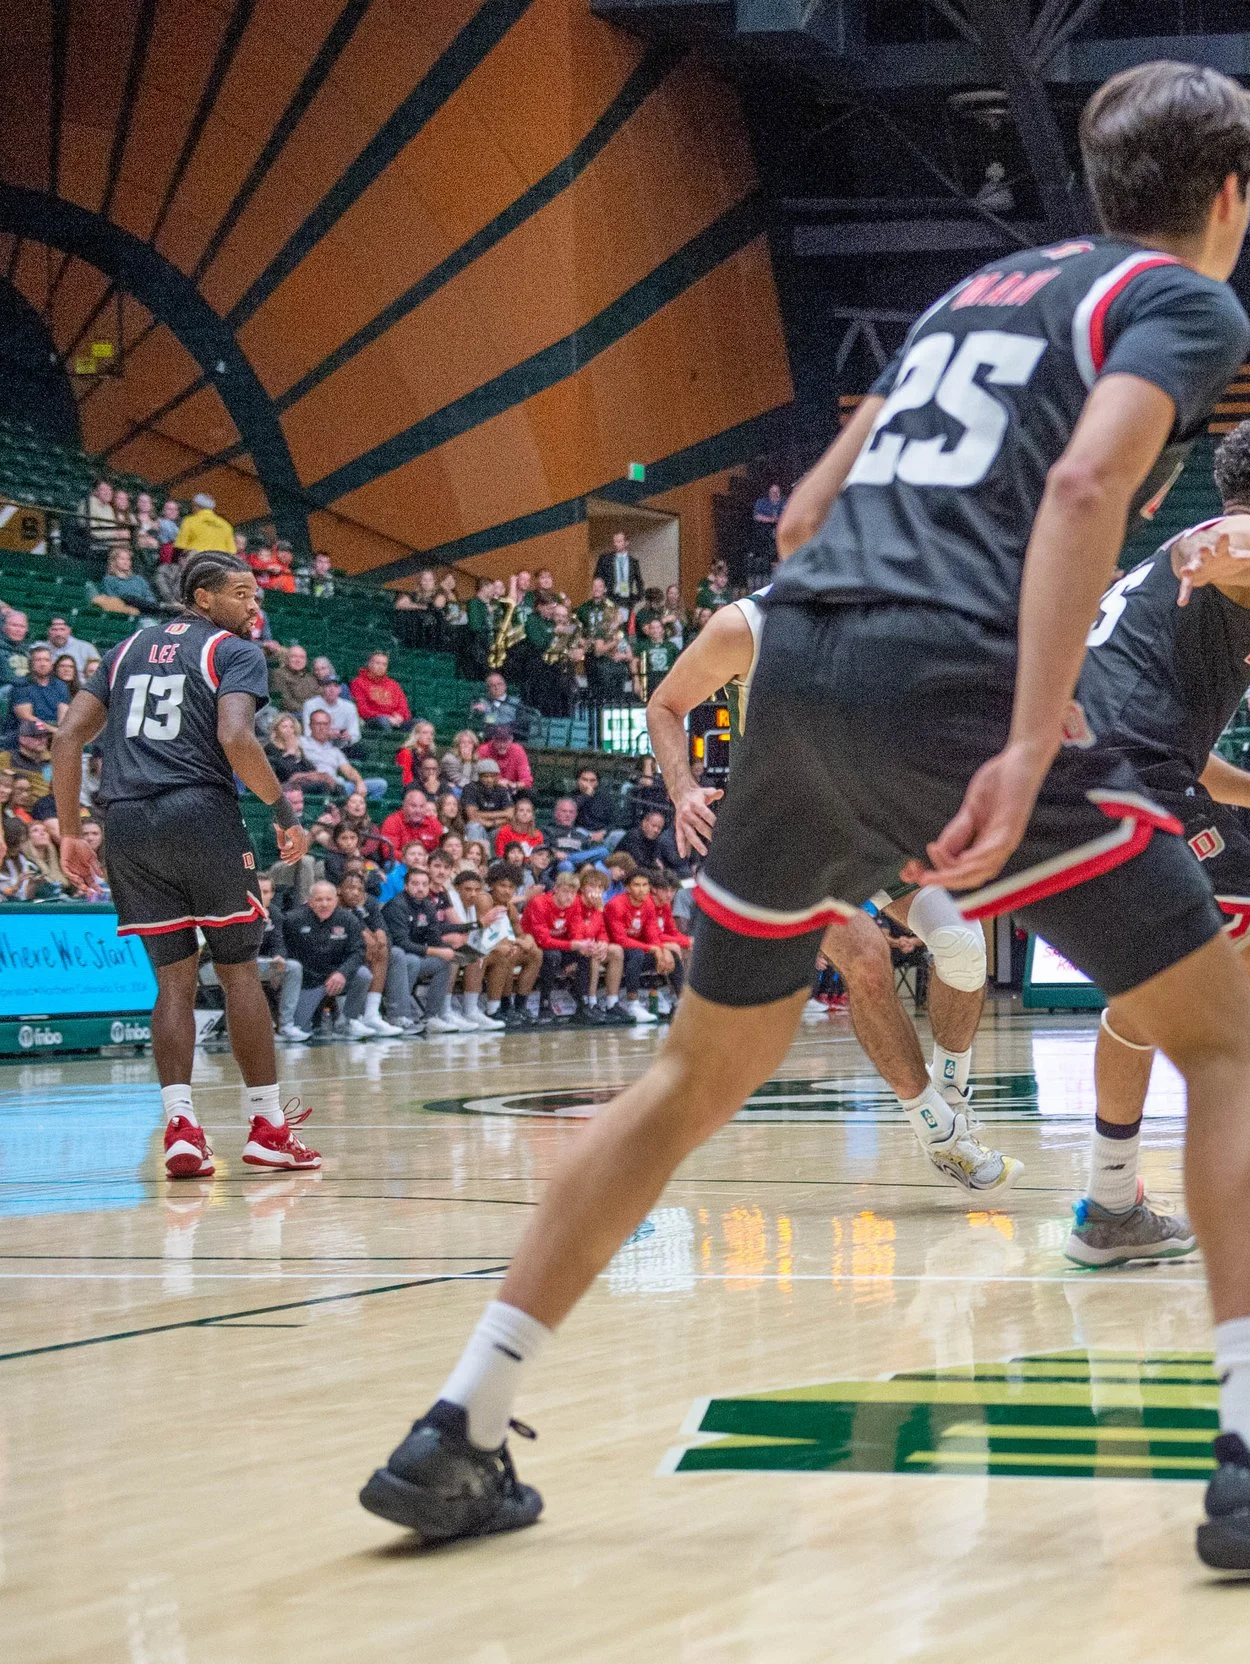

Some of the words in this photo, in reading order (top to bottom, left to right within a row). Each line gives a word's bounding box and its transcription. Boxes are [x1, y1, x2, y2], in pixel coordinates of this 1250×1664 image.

[843, 331, 1048, 487] 25
[148, 644, 180, 664] LEE
[124, 674, 186, 741] 13
[51, 930, 86, 971] We
[84, 931, 138, 968] Start
[33, 1027, 63, 1046] fnbo
